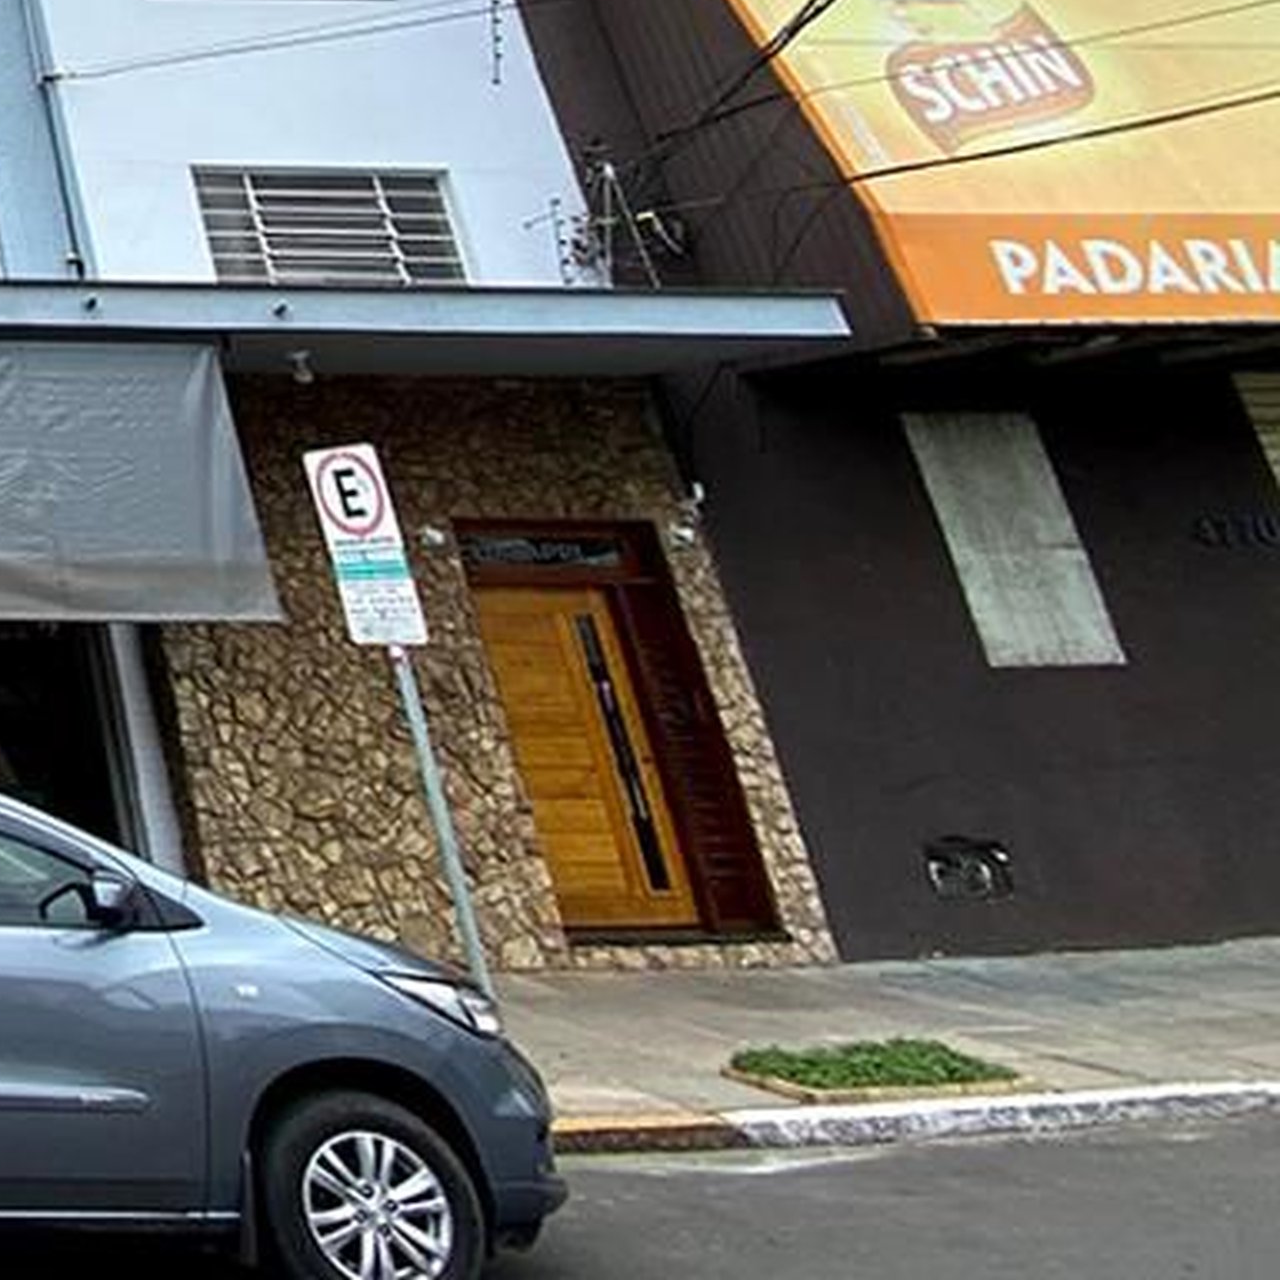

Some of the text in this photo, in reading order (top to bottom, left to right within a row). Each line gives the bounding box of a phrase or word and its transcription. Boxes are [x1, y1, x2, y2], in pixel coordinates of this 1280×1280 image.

[899, 37, 1082, 122] SCHIN
[988, 239, 1280, 294] PADARI
[332, 467, 367, 518] E
